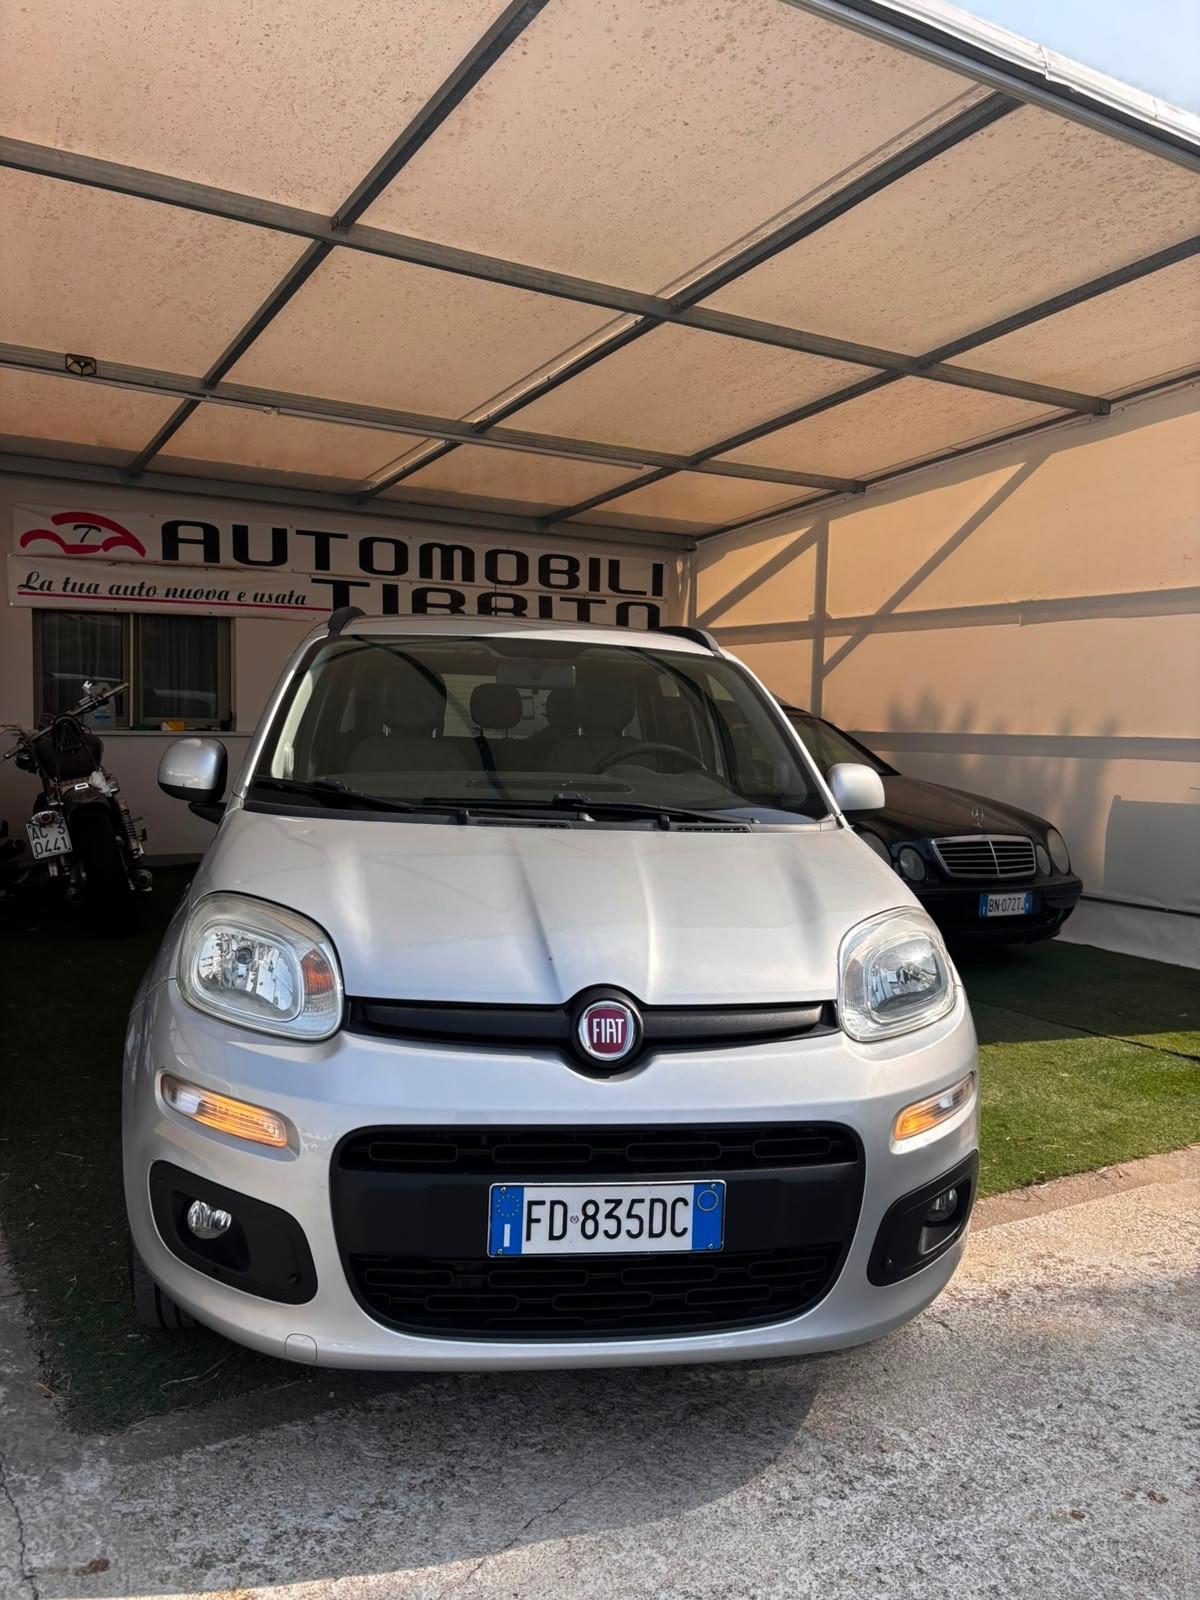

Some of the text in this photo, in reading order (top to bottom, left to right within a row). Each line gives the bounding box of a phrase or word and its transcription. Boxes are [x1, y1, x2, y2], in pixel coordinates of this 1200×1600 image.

[161, 520, 664, 597] AUTOMOBILI
[17, 571, 307, 606] La tua auto nuova e usata
[34, 836, 68, 856] 0441
[592, 1018, 625, 1044] FIAT
